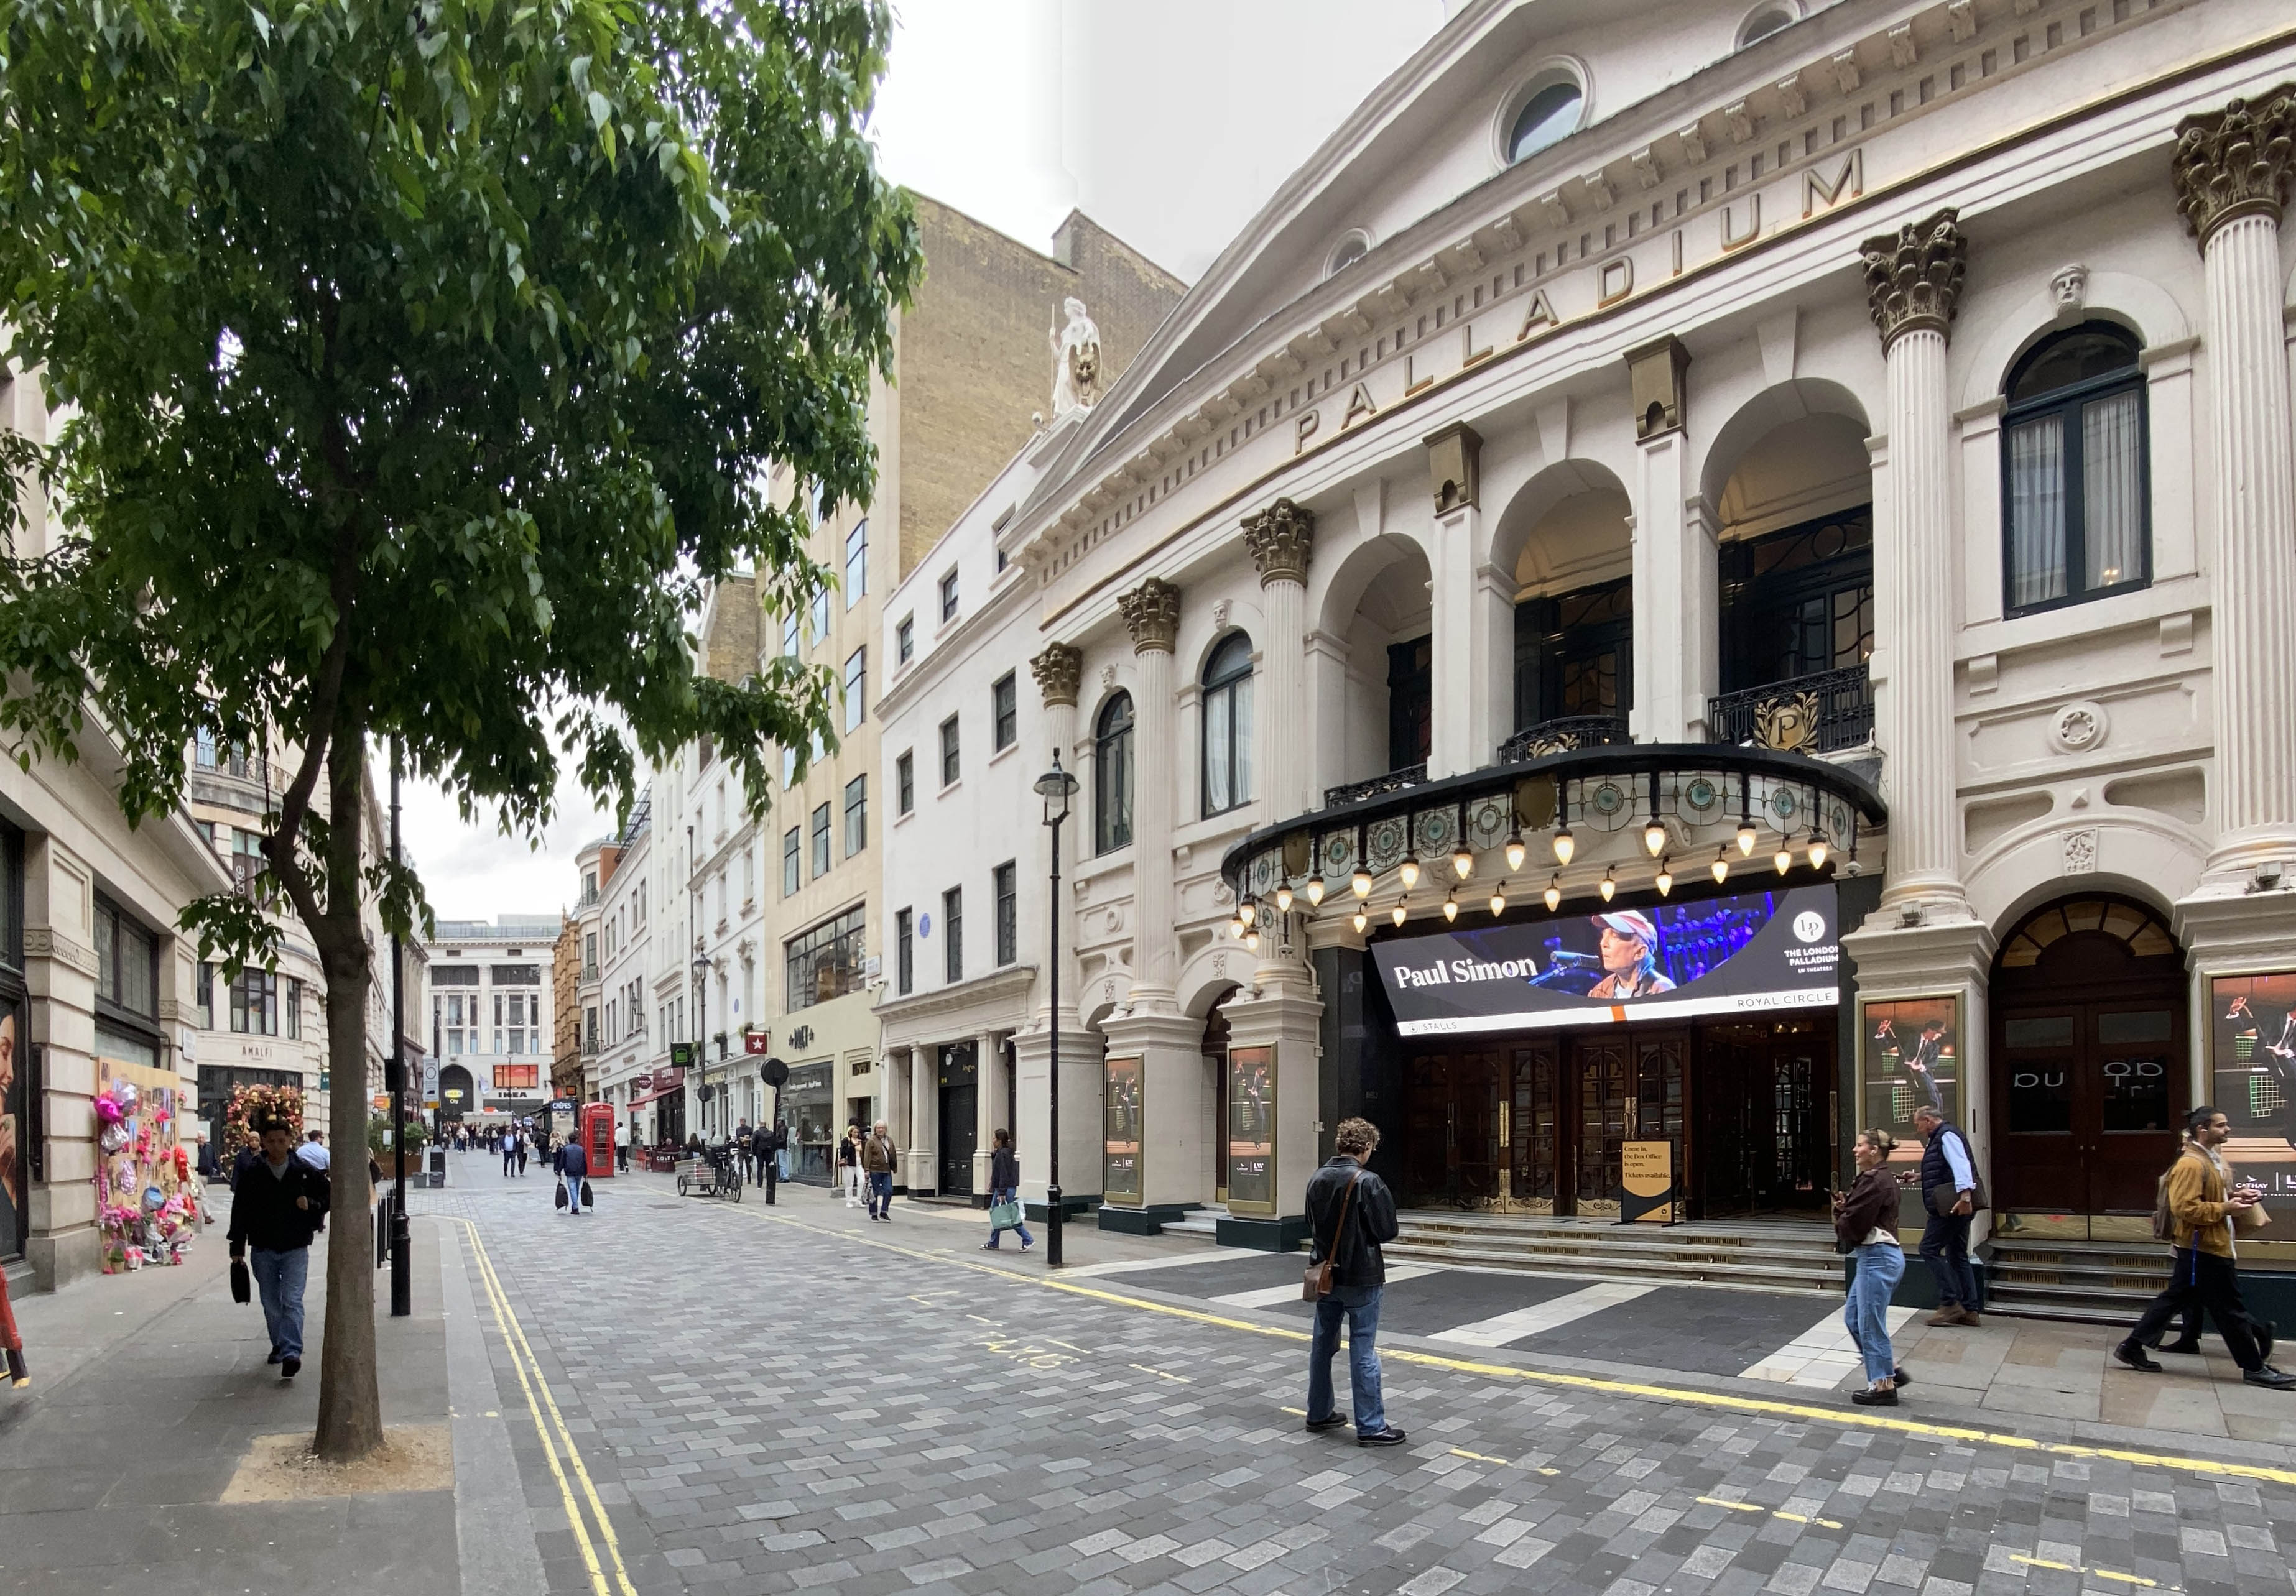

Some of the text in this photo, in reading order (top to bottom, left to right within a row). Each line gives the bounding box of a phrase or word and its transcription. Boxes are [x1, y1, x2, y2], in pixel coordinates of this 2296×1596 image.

[1295, 148, 1863, 455] PALLADIUM
[1784, 949, 1802, 958] THE
[1789, 954, 1839, 967] PALLADIUM
[1394, 960, 1451, 989] Paul
[1451, 958, 1539, 984] Simon
[1807, 965, 1833, 973] THEATRES
[1738, 992, 1833, 1008] ROYAL CIRCLE
[1423, 1021, 1458, 1031] STALLS
[242, 1046, 272, 1058] AMALFI
